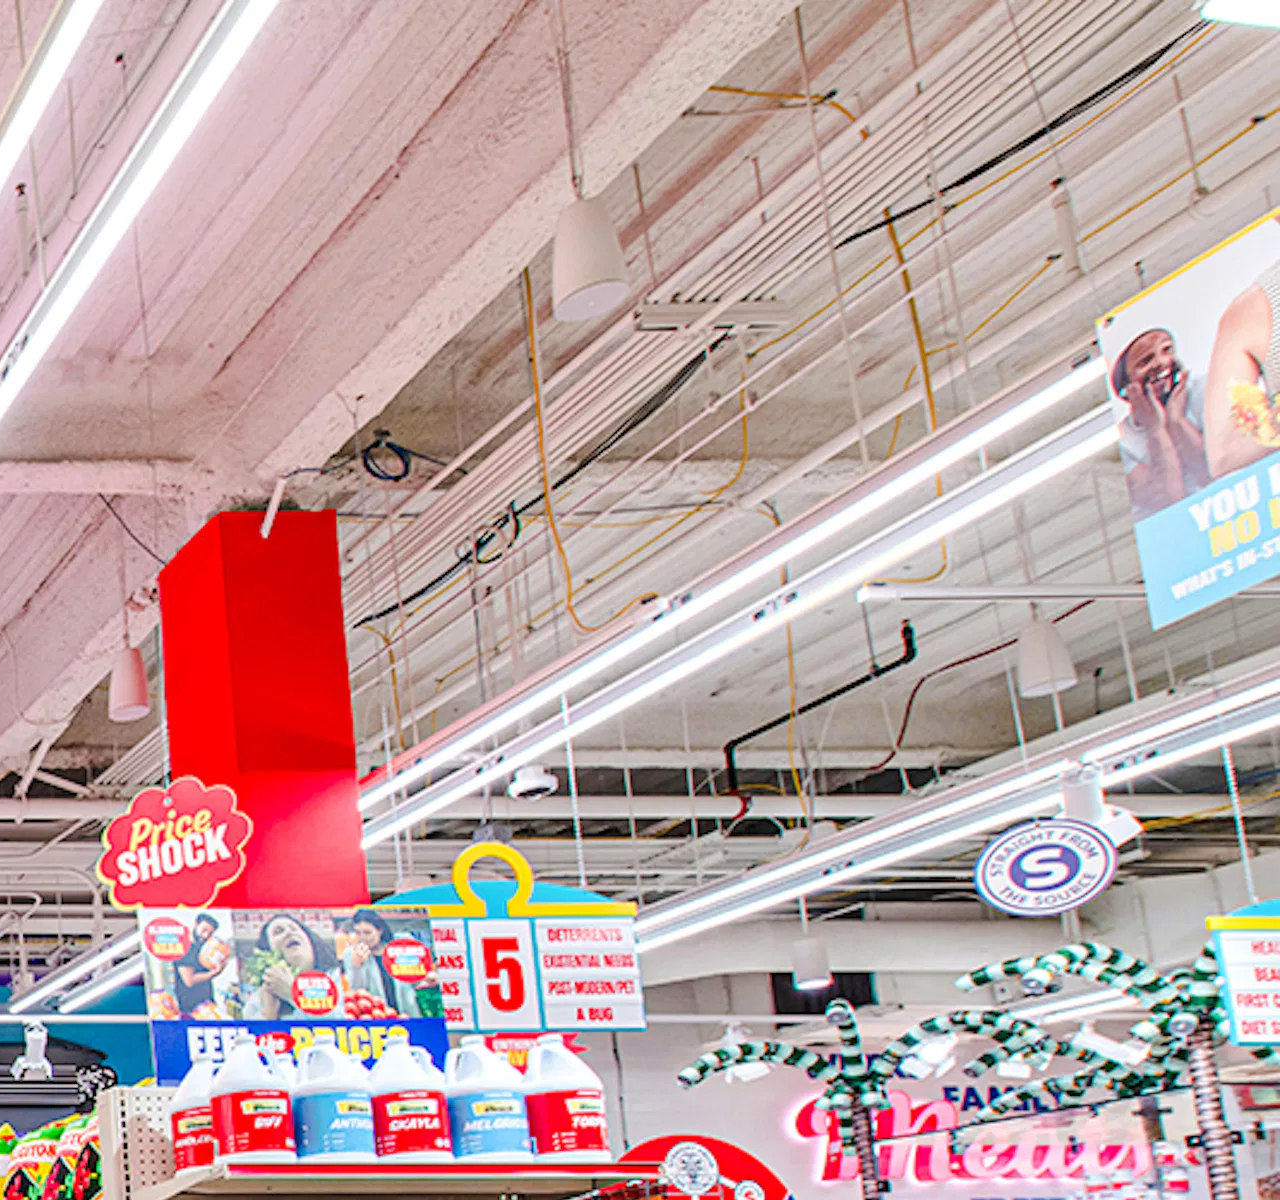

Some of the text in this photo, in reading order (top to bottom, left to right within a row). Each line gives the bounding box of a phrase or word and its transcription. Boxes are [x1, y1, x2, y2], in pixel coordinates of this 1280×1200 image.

[1189, 475, 1260, 532] YOU
[1209, 511, 1261, 557] NO
[1171, 559, 1234, 600] WHAT'S
[129, 806, 211, 849] Price
[116, 823, 232, 887] SHOCK
[990, 830, 1101, 877] STRAIGHT FROM
[1020, 849, 1069, 888] S
[999, 873, 1097, 905] THE SOURCE
[481, 937, 525, 1013] 5
[589, 1007, 613, 1021] BUG
